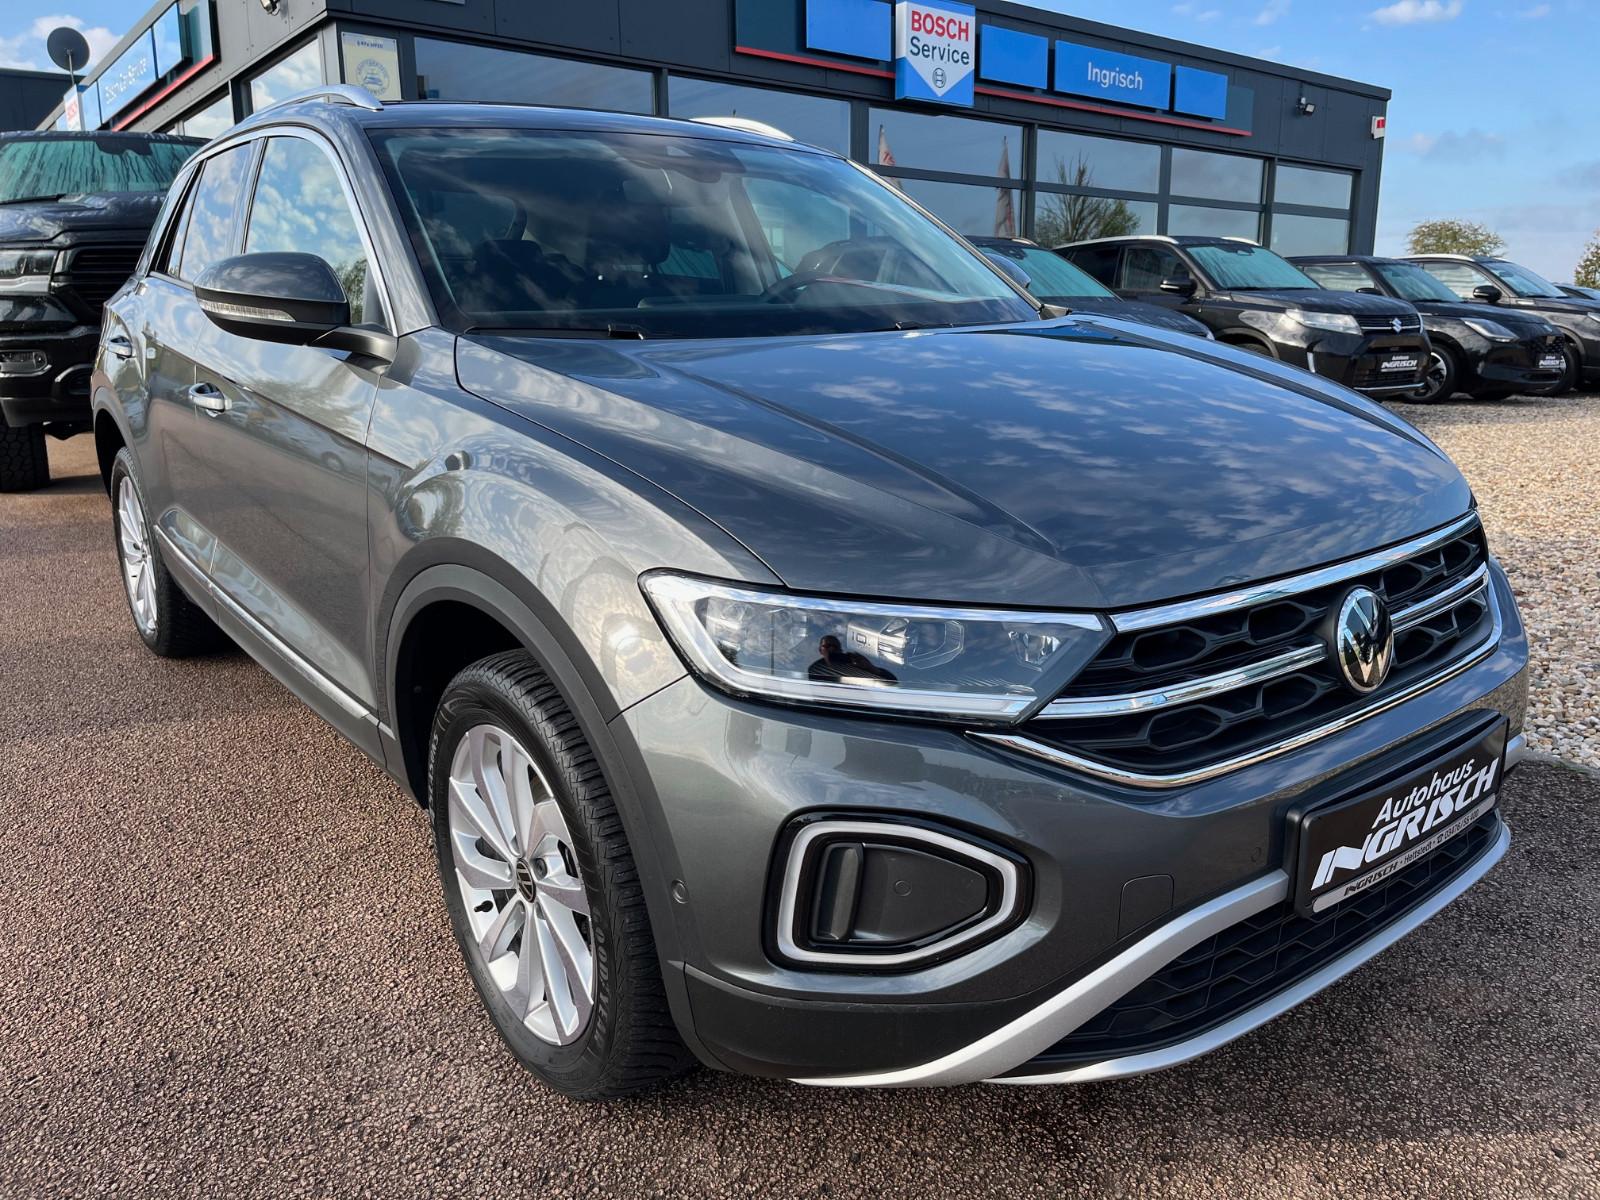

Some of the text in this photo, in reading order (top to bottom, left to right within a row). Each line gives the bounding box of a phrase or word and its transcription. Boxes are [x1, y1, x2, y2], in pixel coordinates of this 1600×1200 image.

[911, 10, 969, 42] BOSCH
[910, 35, 970, 66] Service
[1087, 61, 1143, 91] Ingrisch
[1371, 758, 1475, 830] Autohaus
[1310, 757, 1500, 892] INGRISCH
[1343, 862, 1399, 897] INGRISCH
